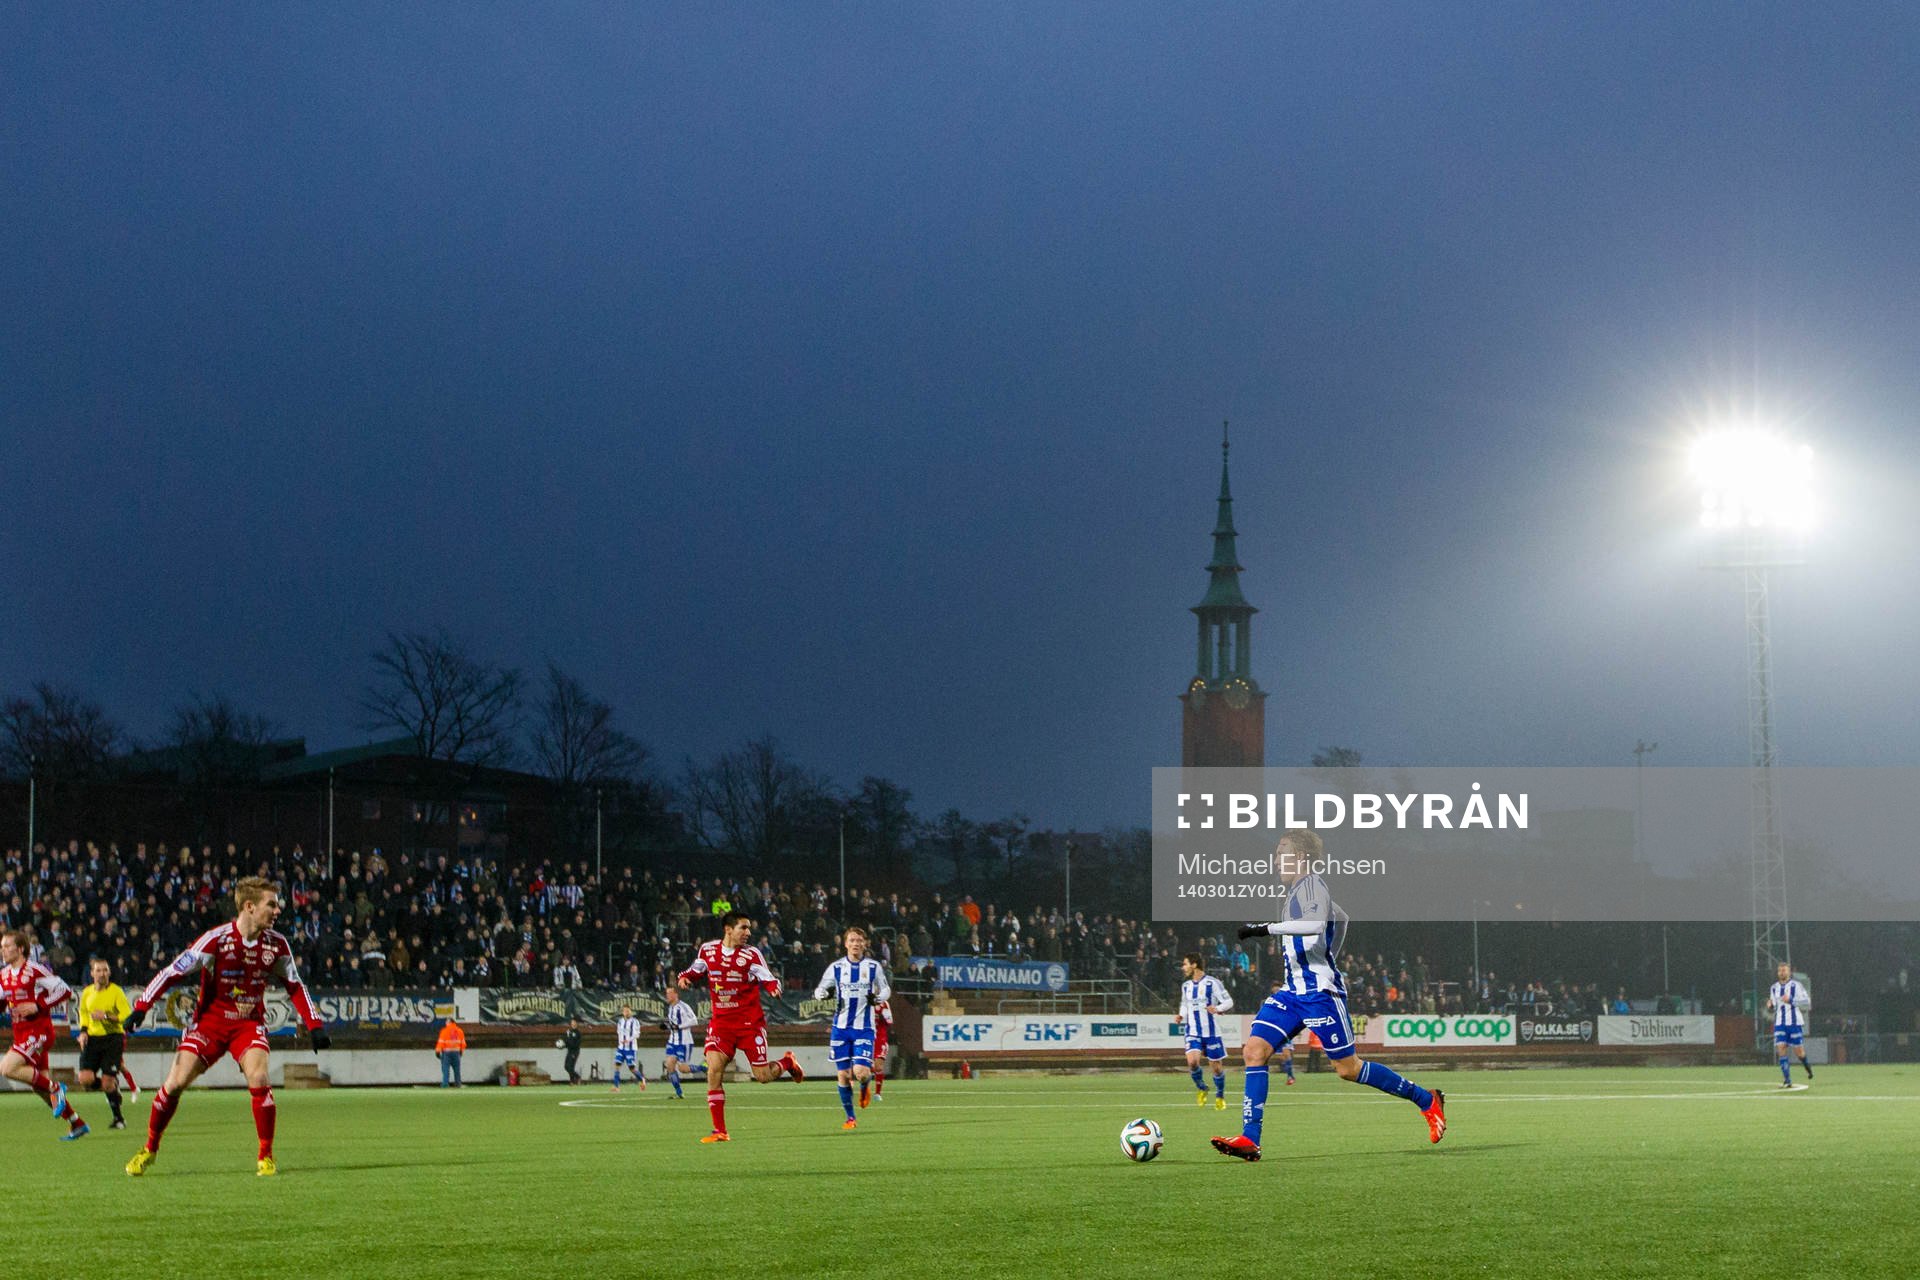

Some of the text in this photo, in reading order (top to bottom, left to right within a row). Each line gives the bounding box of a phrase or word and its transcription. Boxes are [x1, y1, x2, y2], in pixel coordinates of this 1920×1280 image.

[940, 963, 1042, 985] IFK VÄRNAMO
[319, 996, 435, 1023] SUPRAS
[497, 997, 566, 1018] KOPPARBERG
[1101, 1024, 1137, 1036] Danske
[1302, 1015, 1336, 1028] SEFA
[1387, 1019, 1446, 1042] coop
[1454, 1019, 1511, 1042] coop
[1629, 1018, 1684, 1038] Dübliner
[932, 1023, 993, 1042] SKF
[1024, 1023, 1082, 1041] SKF
[1330, 1033, 1339, 1044] 6
[756, 1046, 766, 1054] 10
